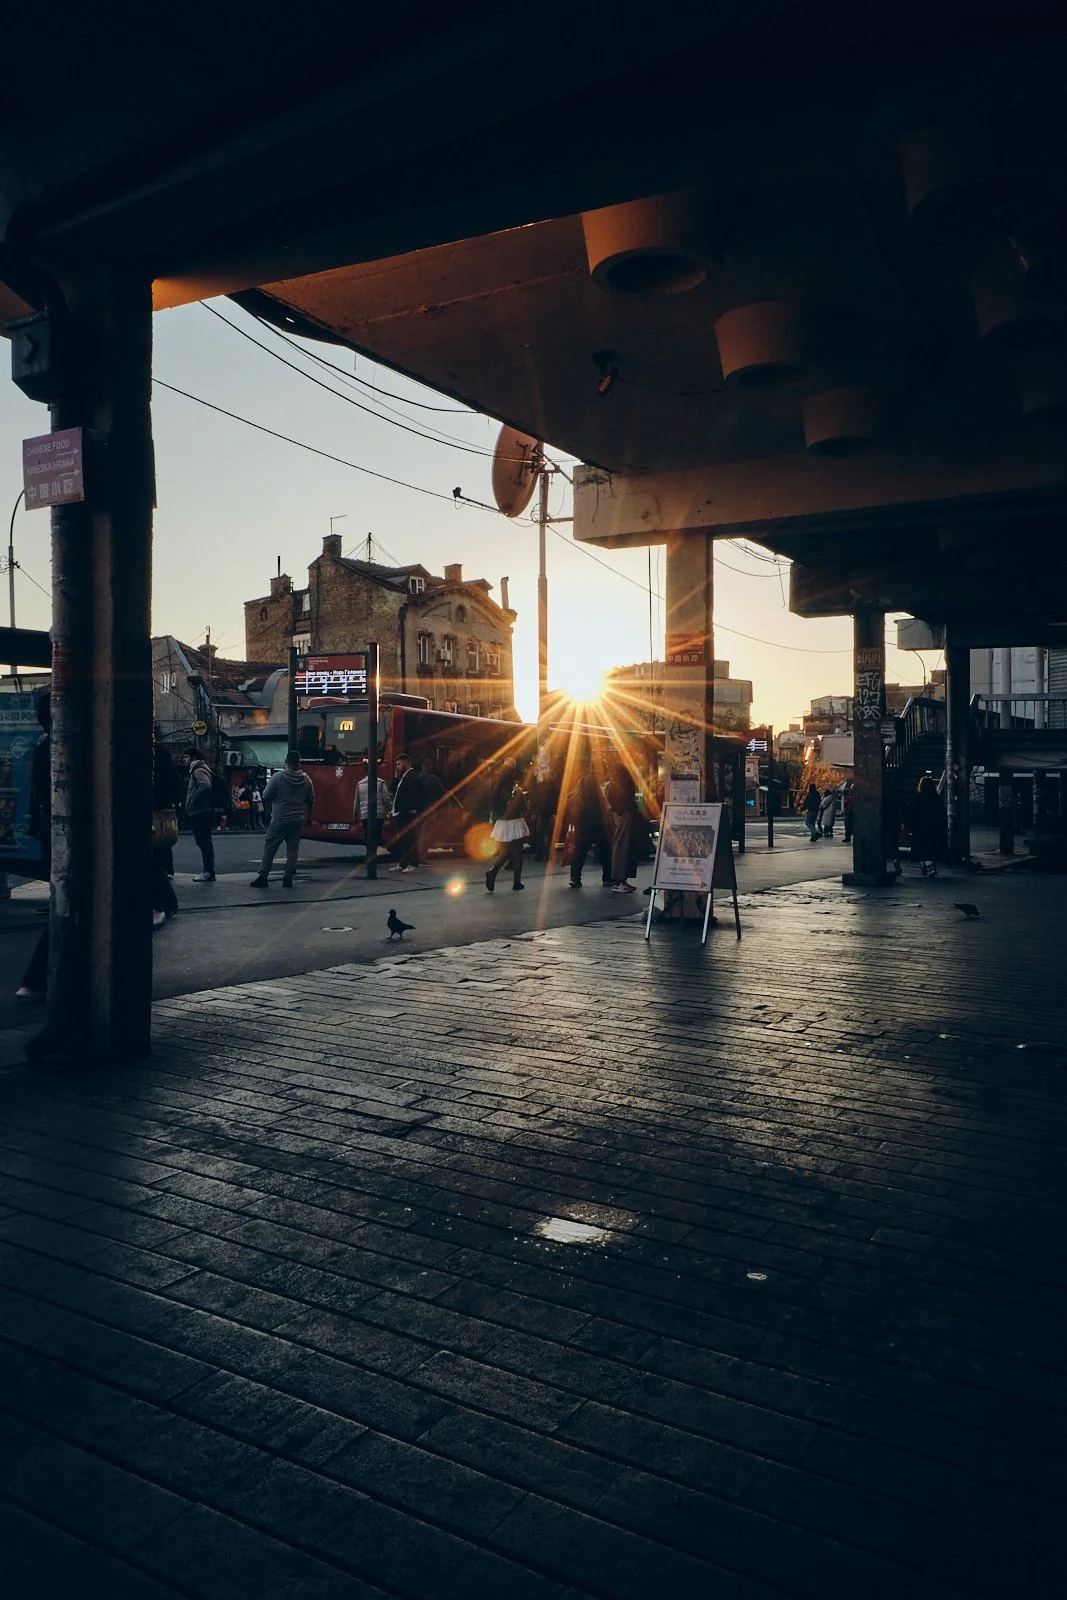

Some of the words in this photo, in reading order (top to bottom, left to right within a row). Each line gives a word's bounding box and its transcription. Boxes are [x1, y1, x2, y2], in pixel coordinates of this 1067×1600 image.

[26, 442, 52, 457] CHINESE
[53, 439, 70, 450] FOOD
[27, 462, 52, 475] KINESKA
[53, 458, 75, 470] HRANA
